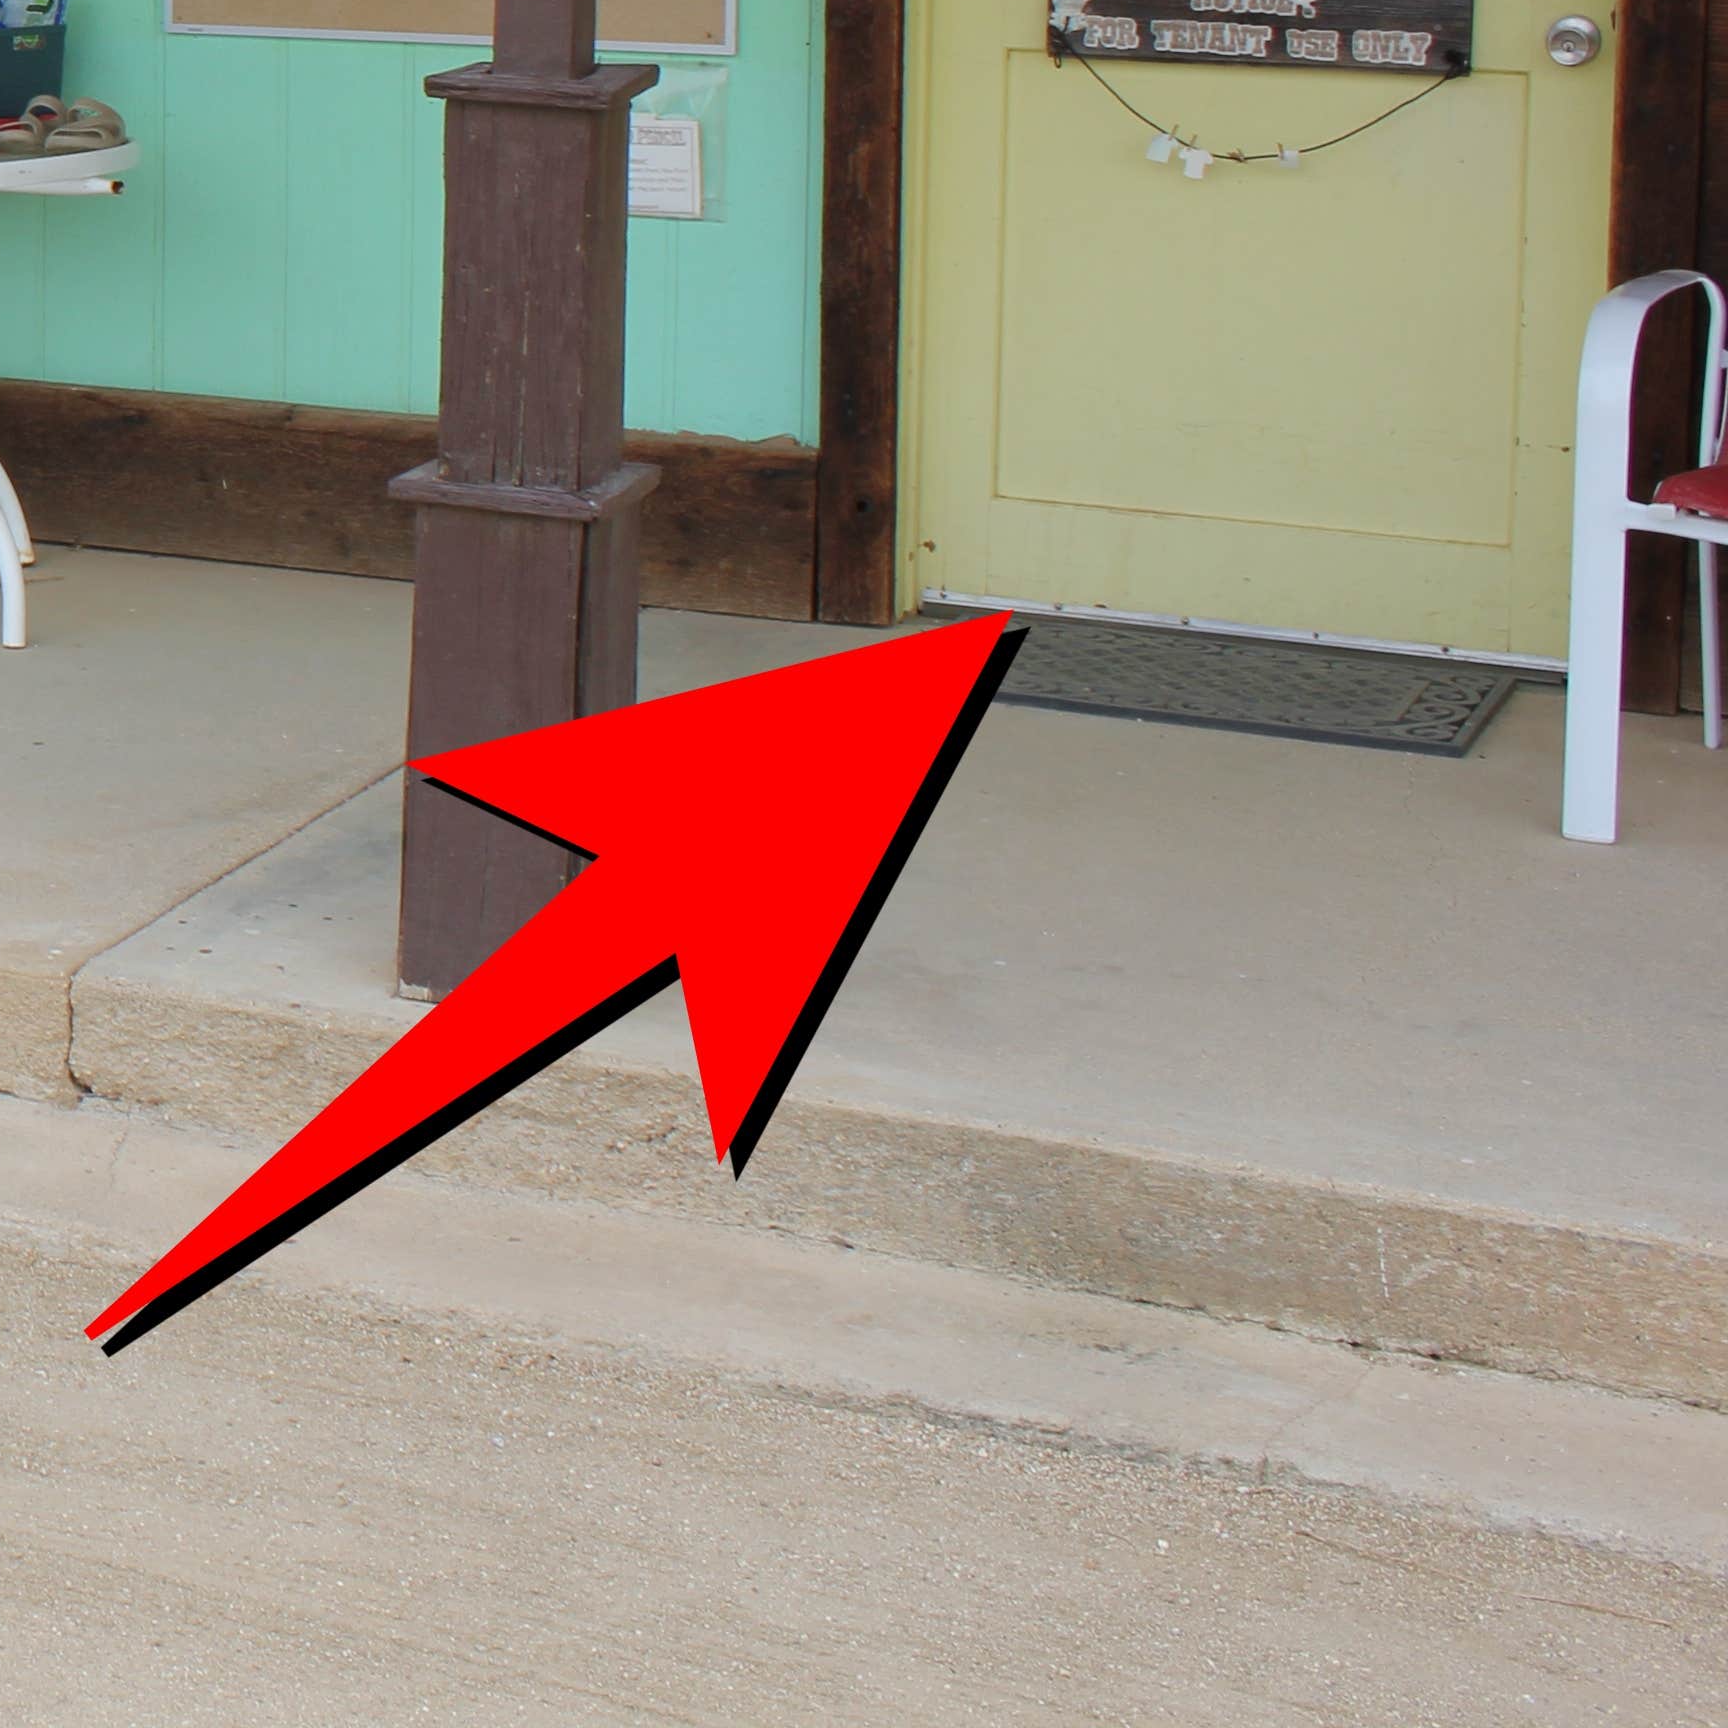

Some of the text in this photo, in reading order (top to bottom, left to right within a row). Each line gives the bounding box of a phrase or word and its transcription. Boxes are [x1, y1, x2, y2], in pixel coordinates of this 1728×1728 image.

[1084, 15, 1431, 66] FOR TENANT USE ONLY
